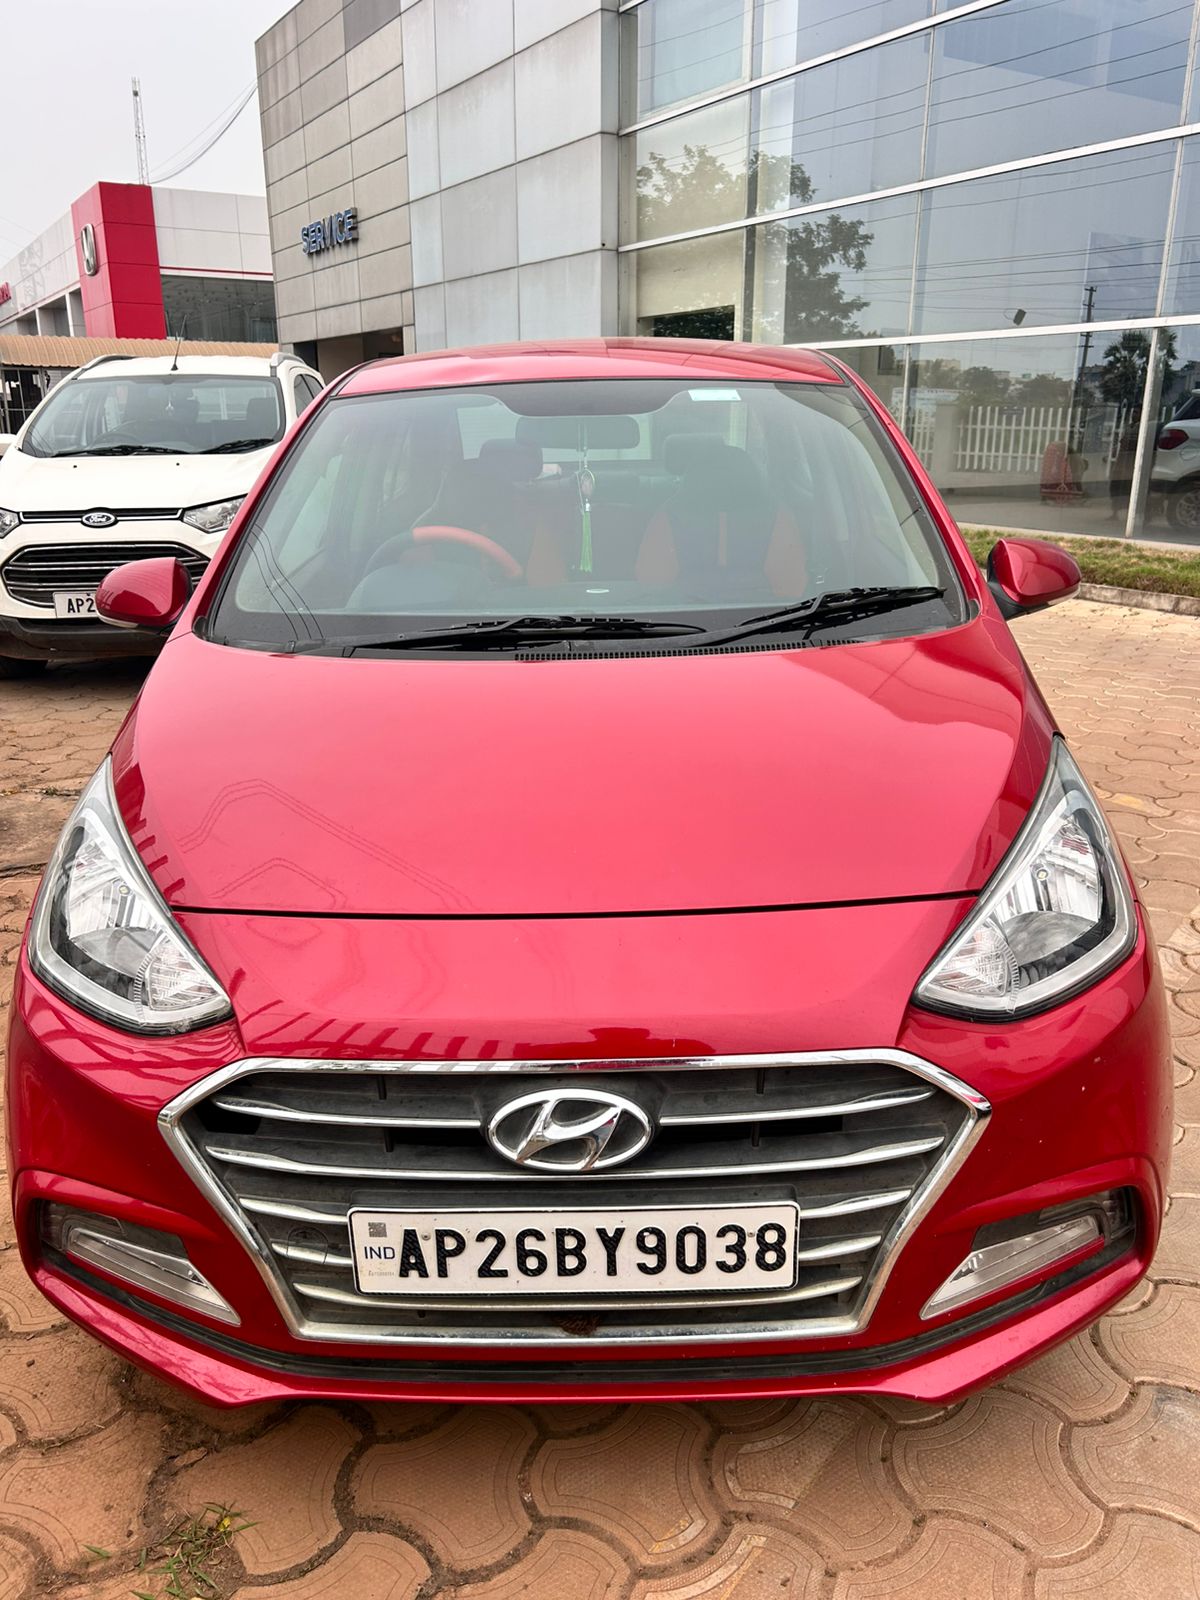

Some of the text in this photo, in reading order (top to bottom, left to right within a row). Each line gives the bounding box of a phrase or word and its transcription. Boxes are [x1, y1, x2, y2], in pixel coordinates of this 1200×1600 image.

[301, 208, 358, 255] SERVICE
[67, 597, 96, 613] AP2
[364, 1246, 395, 1259] IND
[399, 1222, 787, 1278] AP26BY9038
